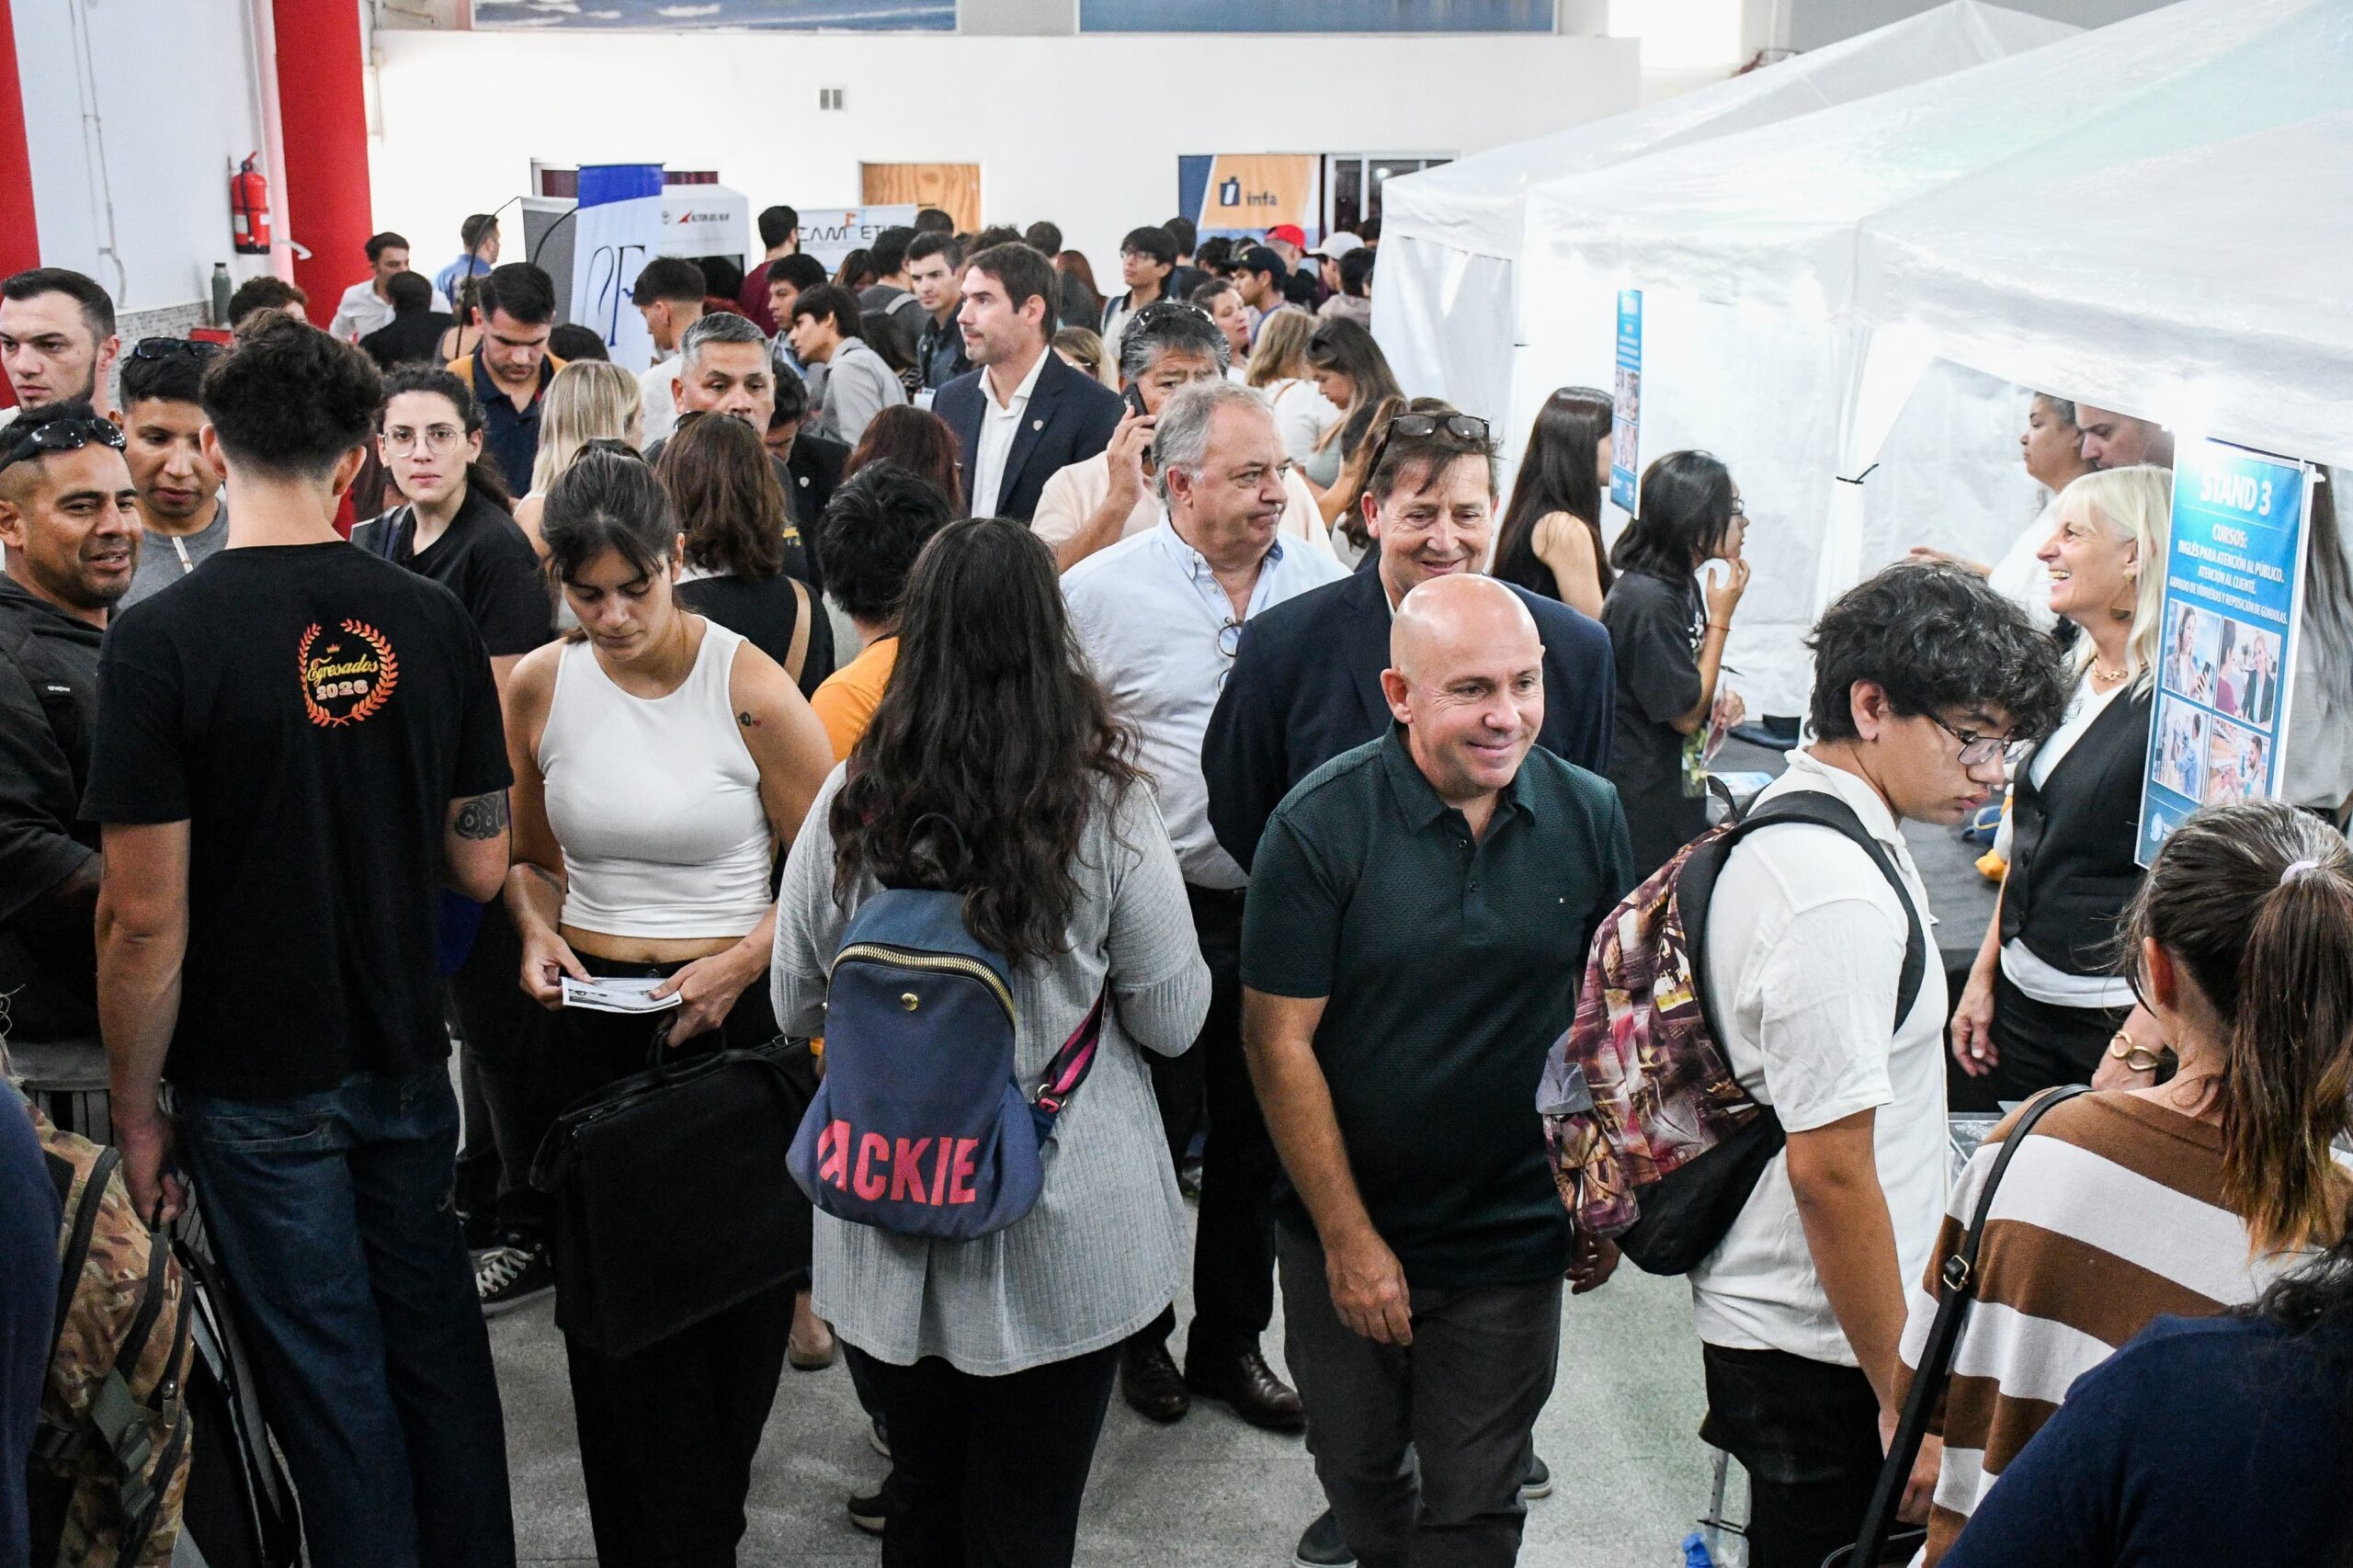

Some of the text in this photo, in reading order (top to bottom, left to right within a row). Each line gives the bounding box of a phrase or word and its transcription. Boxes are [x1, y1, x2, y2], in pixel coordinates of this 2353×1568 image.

[1246, 191, 1278, 206] infa
[2200, 473, 2272, 517] STAND 3
[2212, 524, 2248, 549] CURSOS:
[2200, 545, 2216, 562] PARA
[2217, 551, 2245, 570] ATENCIÓN
[307, 653, 379, 687] Egresados
[316, 679, 369, 700] 2026
